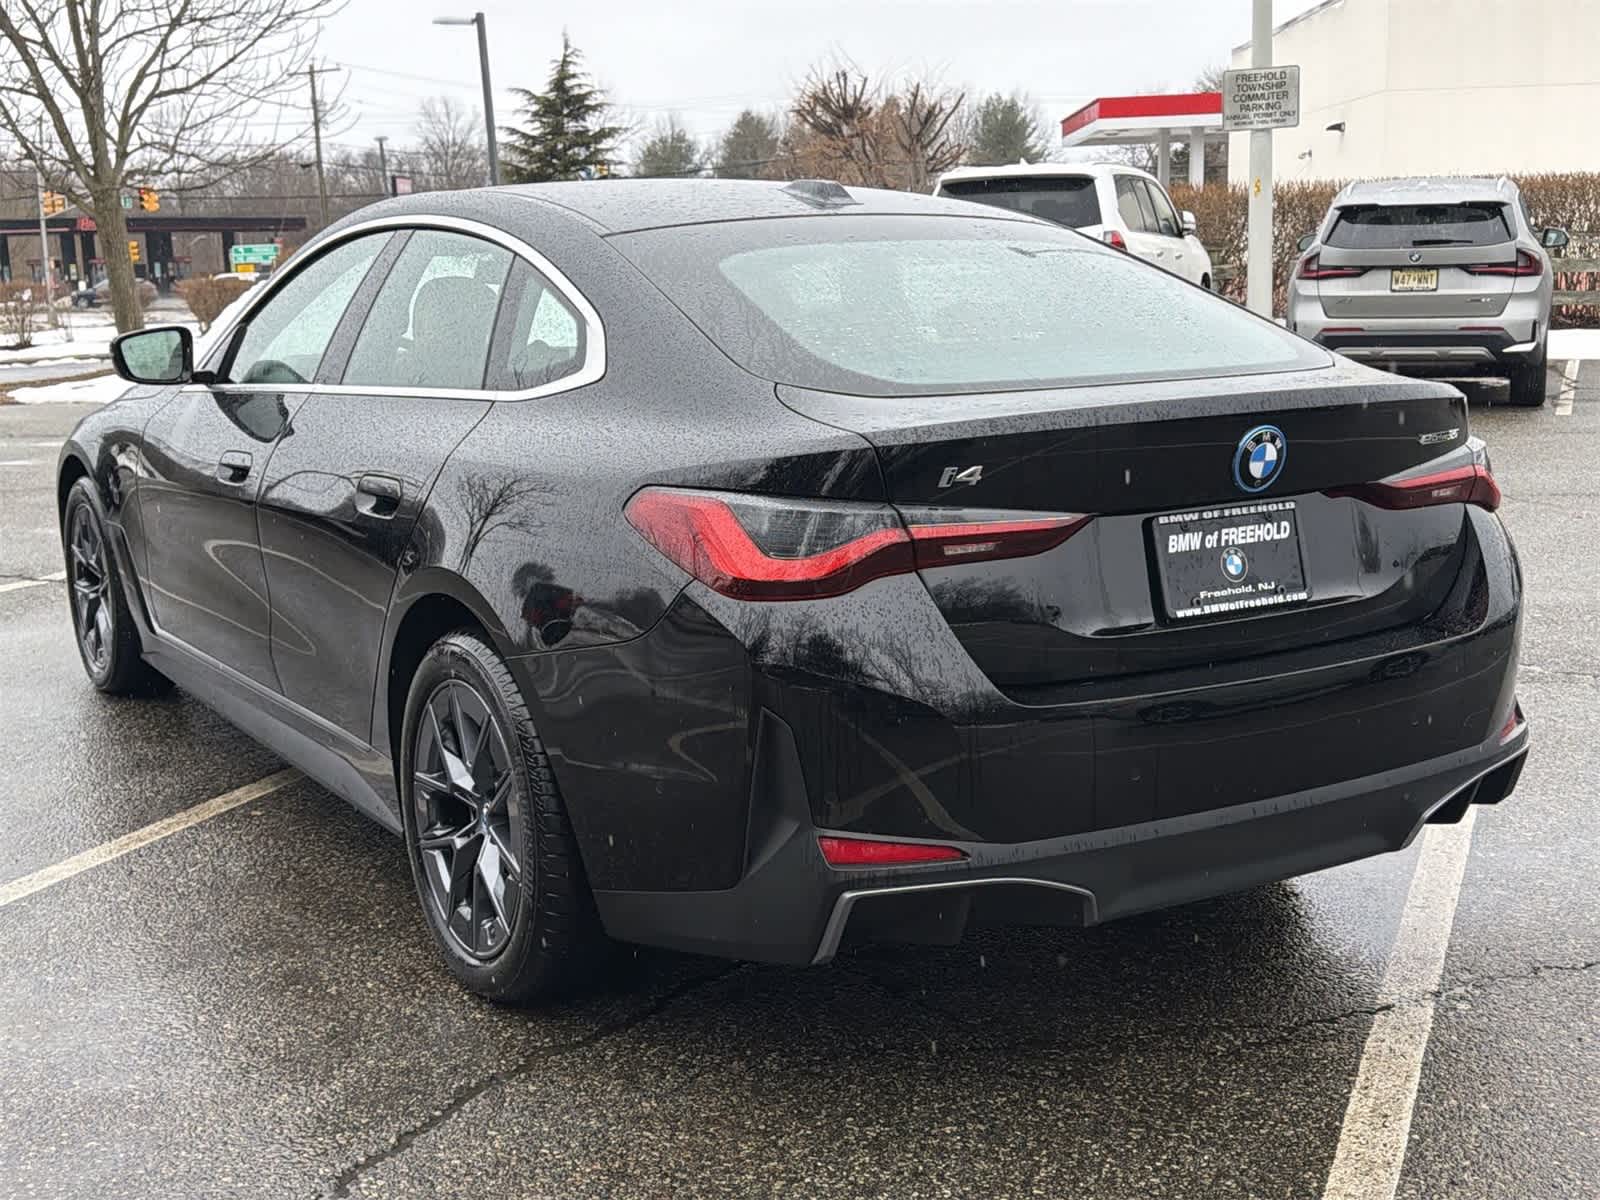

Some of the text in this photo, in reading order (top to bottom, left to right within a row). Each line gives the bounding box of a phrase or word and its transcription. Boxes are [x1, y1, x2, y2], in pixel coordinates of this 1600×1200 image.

[1235, 71, 1287, 83] FREEHOLD
[1236, 80, 1287, 92] TOWNSHIP
[1232, 90, 1289, 103] COMMUTER
[1239, 101, 1282, 112] PARKING
[1279, 110, 1297, 118] ONLY
[1246, 431, 1283, 452] BMW
[937, 465, 984, 488] i4
[1158, 501, 1296, 524] BMW OF FREEHOLD
[1168, 521, 1291, 553] BMW of FREEHOLD
[1199, 581, 1276, 599] Freehold, NJ
